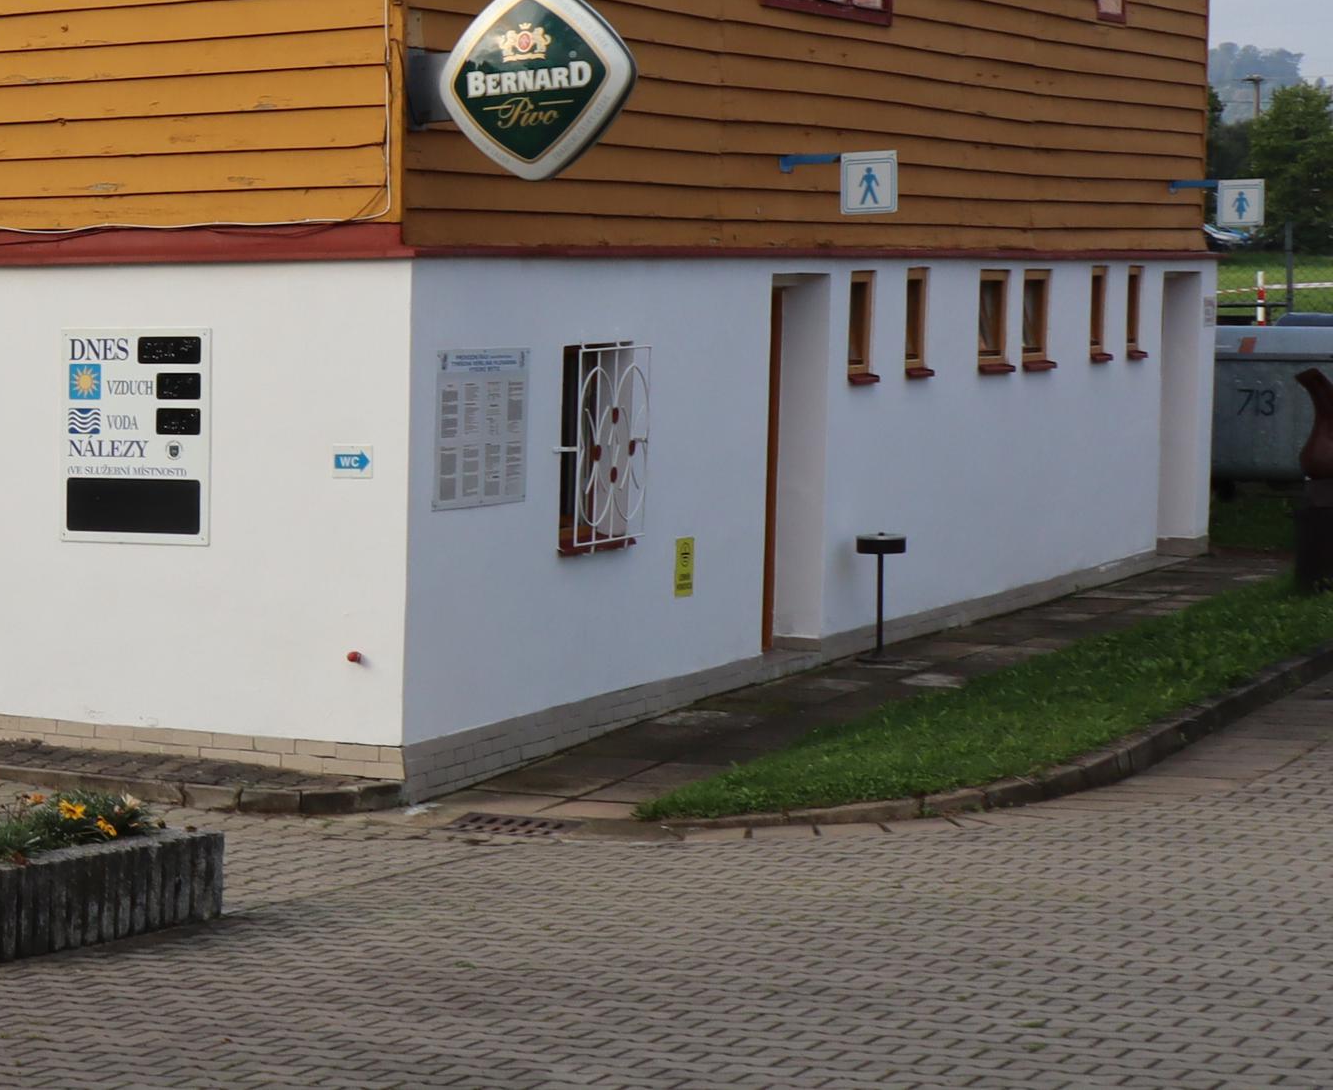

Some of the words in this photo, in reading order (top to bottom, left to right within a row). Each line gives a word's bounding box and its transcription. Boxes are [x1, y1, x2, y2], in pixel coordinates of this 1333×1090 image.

[466, 60, 592, 98] BERNARD
[497, 97, 560, 129] Pivo
[69, 338, 129, 361] DNES
[107, 380, 154, 396] VZDUCH
[107, 415, 139, 431] VODA
[68, 435, 149, 458] NÁLEZY
[85, 464, 131, 476] SLUŽEBNÍ
[340, 456, 360, 467] WC
